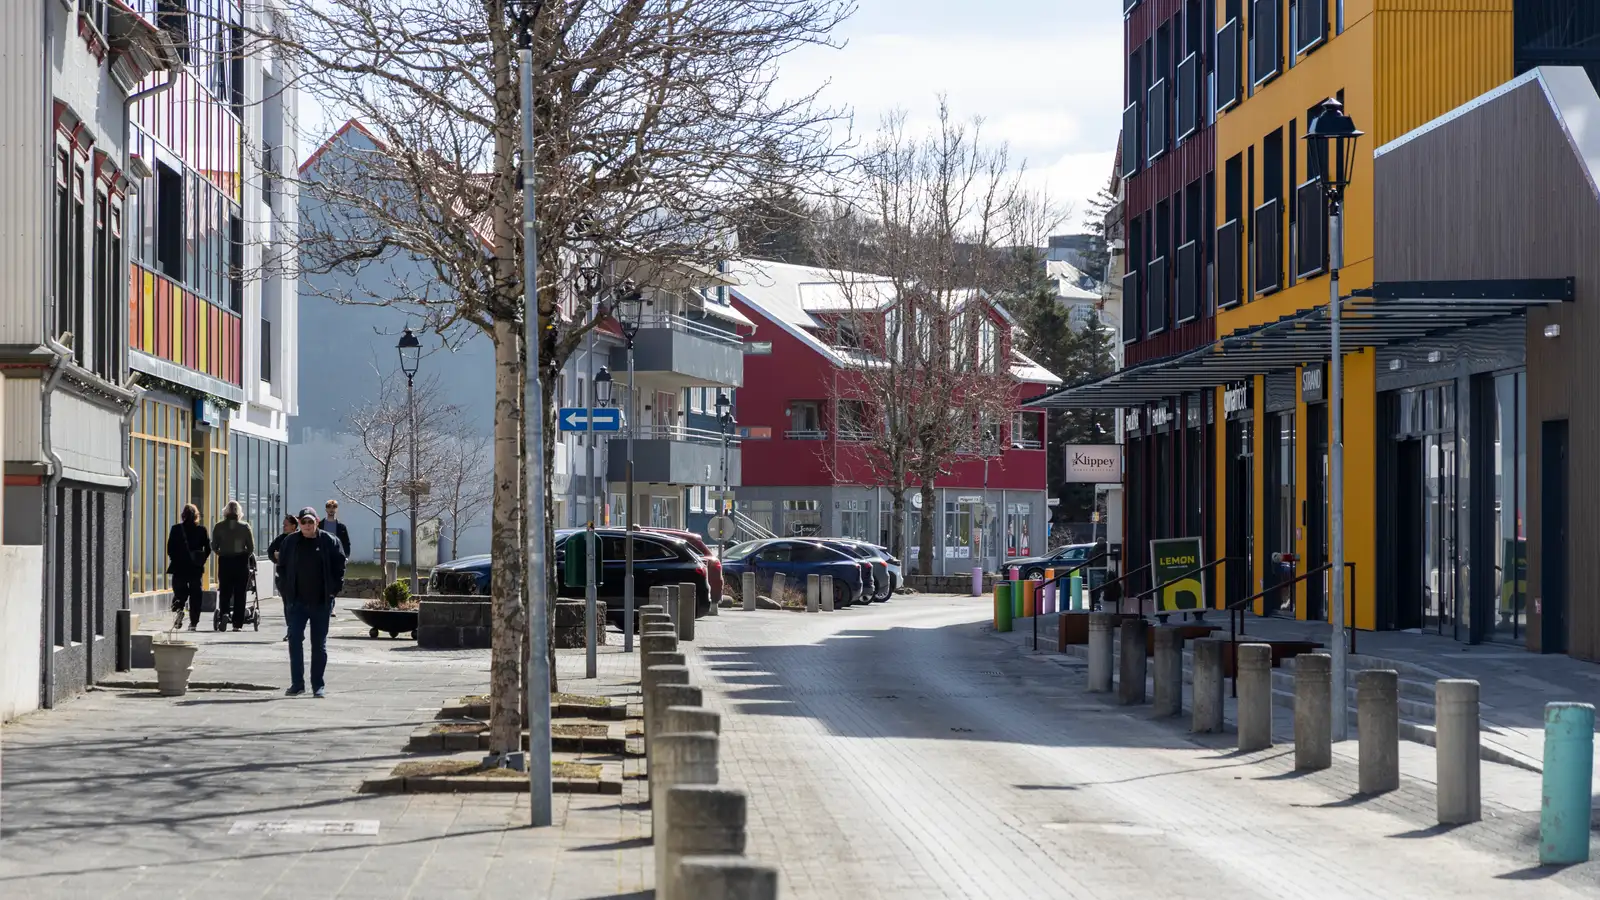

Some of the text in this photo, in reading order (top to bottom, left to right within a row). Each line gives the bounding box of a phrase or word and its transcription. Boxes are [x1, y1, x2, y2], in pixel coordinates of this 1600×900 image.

[1302, 369, 1321, 391] STRAND
[1072, 452, 1115, 467] Klippey
[1159, 555, 1195, 566] LEMON
